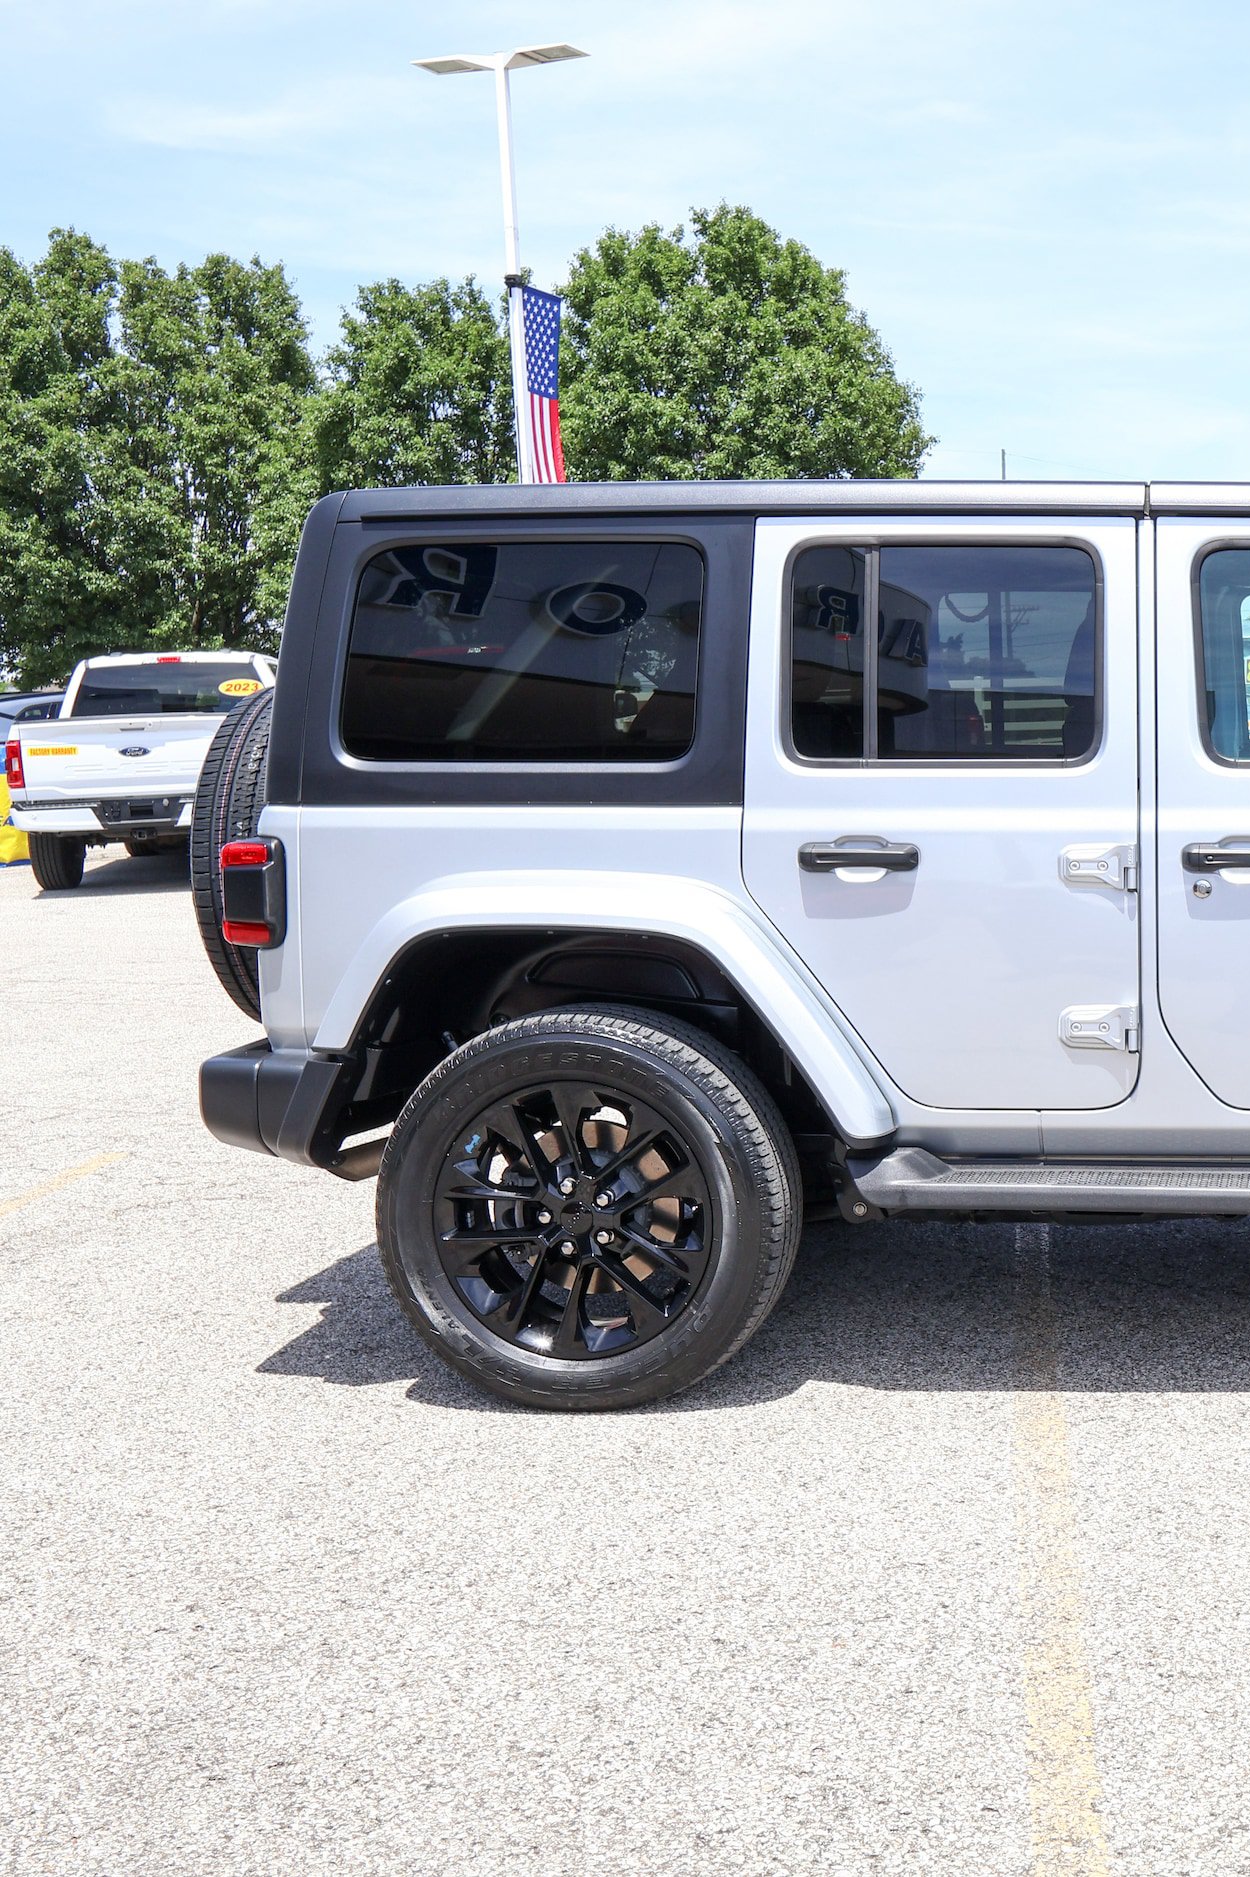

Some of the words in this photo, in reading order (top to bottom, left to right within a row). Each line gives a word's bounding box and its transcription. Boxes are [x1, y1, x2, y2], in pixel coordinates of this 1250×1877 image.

[224, 682, 259, 693] 2023
[29, 747, 50, 757] FACTORY
[51, 747, 77, 756] WARRANTY
